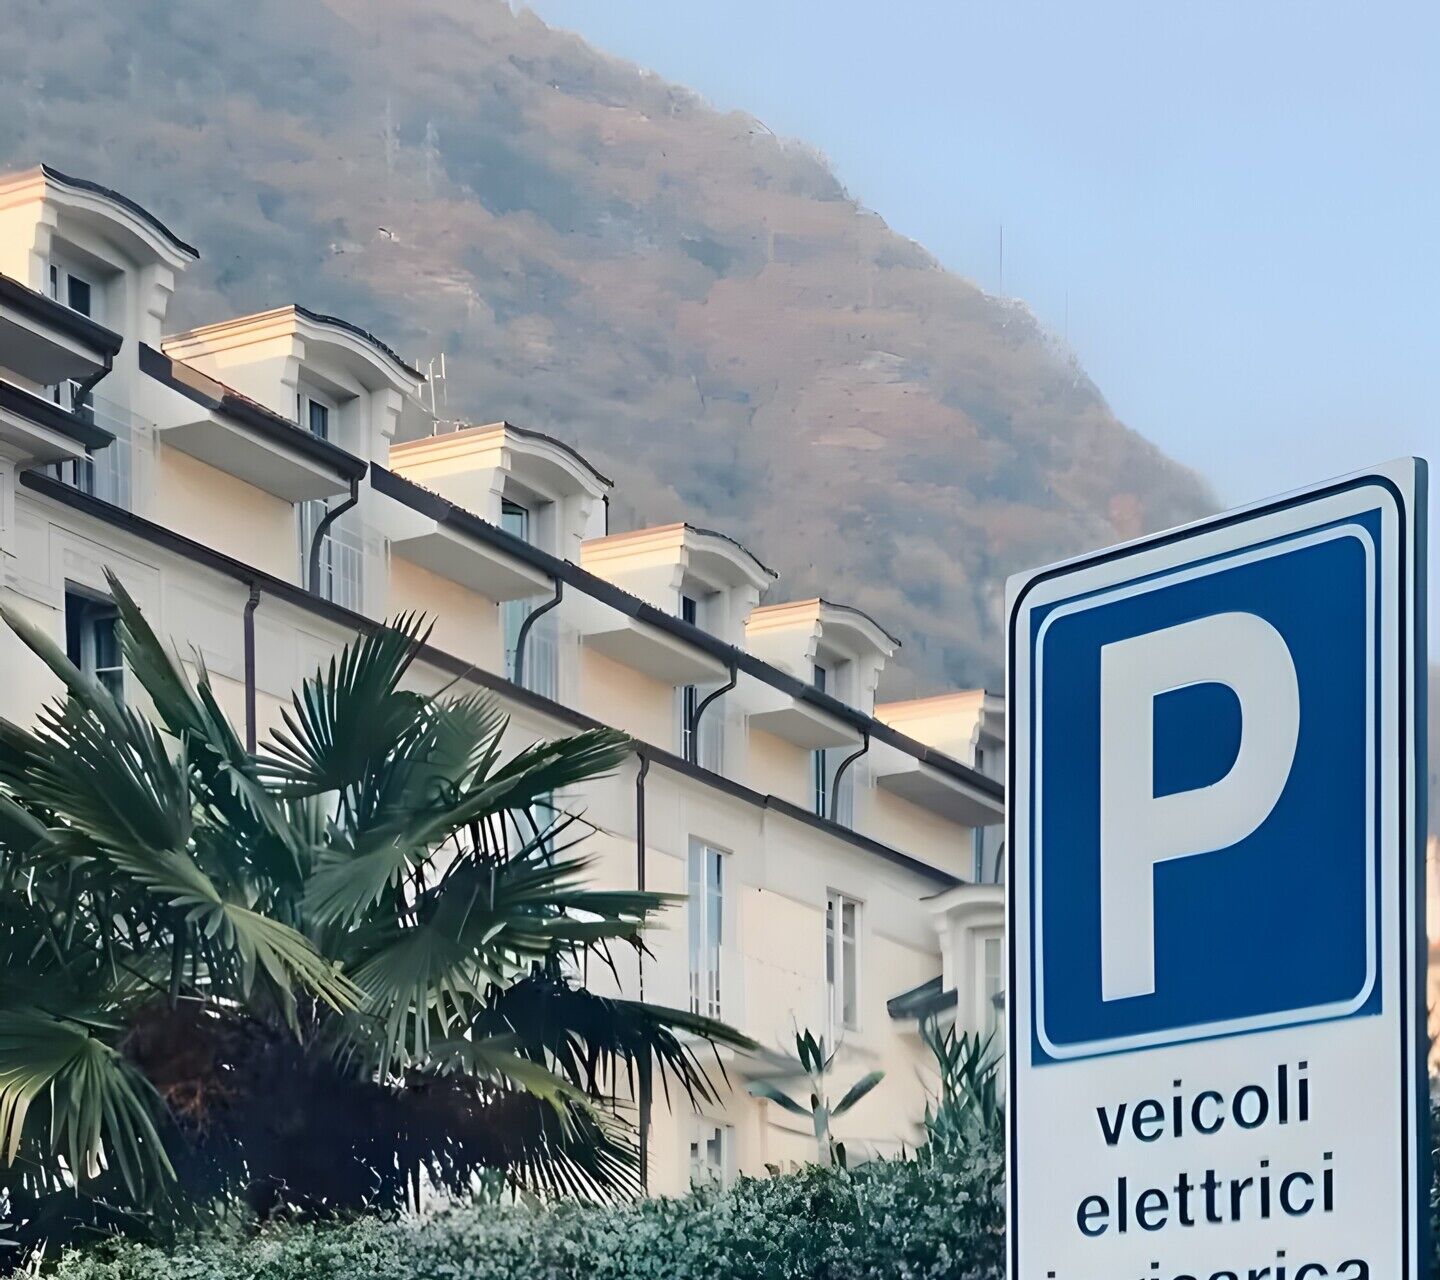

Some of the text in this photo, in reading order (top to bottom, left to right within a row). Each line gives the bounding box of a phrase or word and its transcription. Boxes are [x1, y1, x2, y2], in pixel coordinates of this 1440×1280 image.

[1100, 610, 1301, 1002] P
[1095, 1060, 1311, 1148] veicoli
[1076, 1152, 1335, 1238] elettrici
